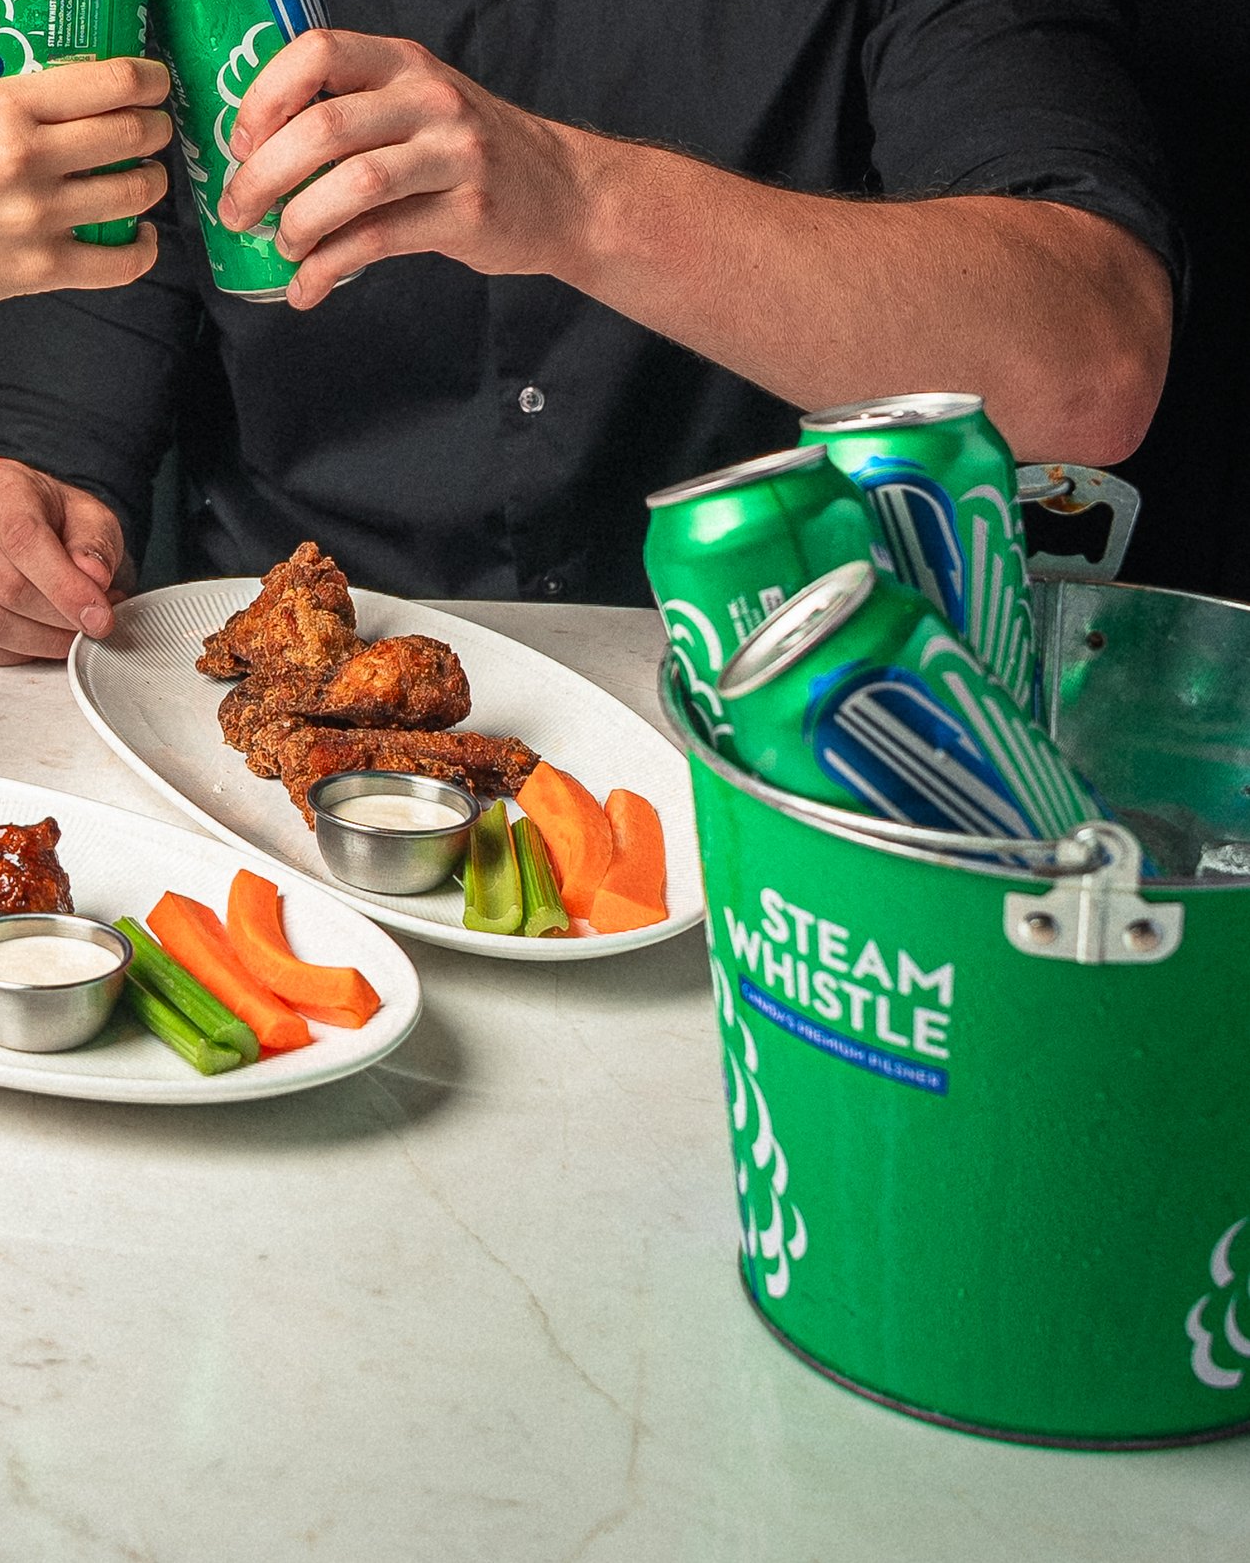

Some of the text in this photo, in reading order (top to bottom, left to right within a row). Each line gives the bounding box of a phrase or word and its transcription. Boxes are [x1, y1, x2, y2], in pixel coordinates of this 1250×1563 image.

[48, 23, 56, 47] STEAM
[65, 22, 73, 47] Toronto,
[723, 905, 950, 1060] WHISTLE
[760, 887, 954, 1008] STEAM
[797, 1018, 865, 1062] PREMIUM
[867, 1051, 942, 1088] PILSNER
